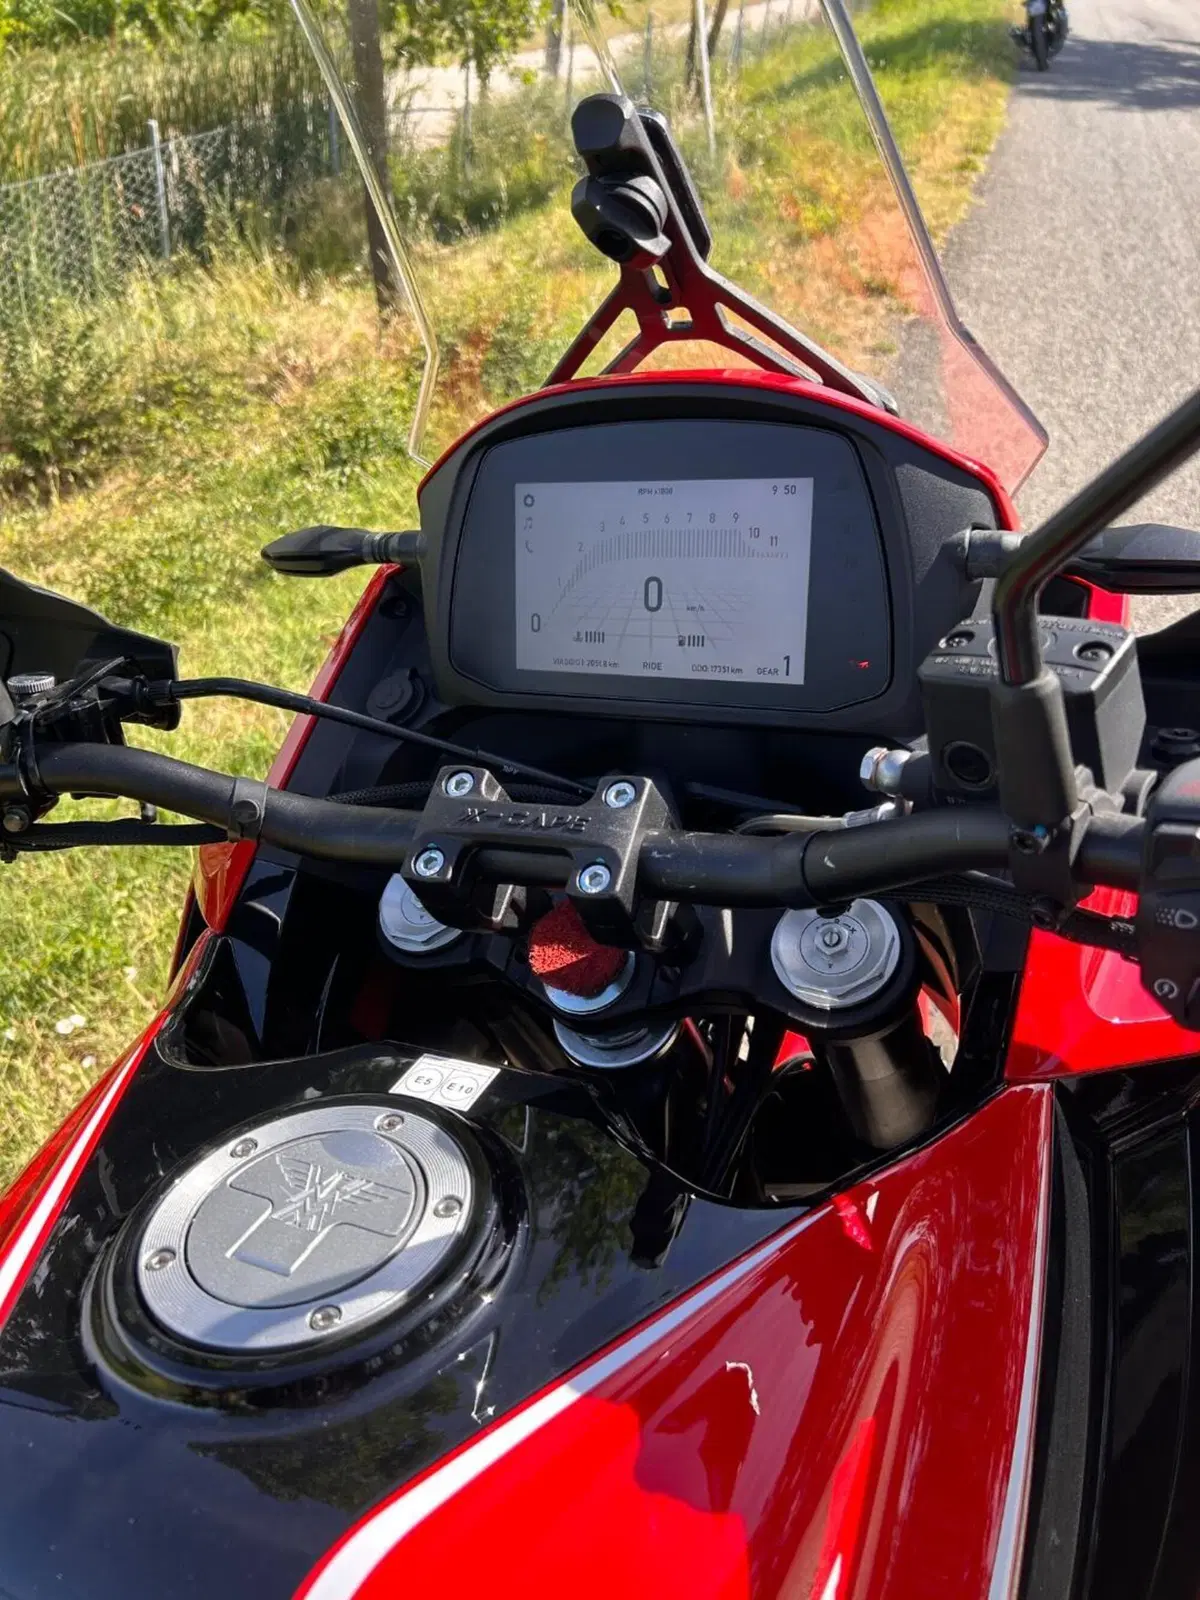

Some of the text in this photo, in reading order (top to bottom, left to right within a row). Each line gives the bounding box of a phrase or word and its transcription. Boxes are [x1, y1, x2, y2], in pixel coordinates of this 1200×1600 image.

[784, 484, 797, 495] 50
[577, 541, 584, 552] 2
[600, 521, 606, 532] 3
[619, 515, 626, 525] 4
[642, 513, 649, 523] 5
[664, 513, 670, 524] 6
[686, 512, 693, 523] 7
[709, 512, 716, 523] 8
[733, 512, 740, 523] 9
[748, 527, 760, 539] 10
[769, 535, 778, 547] 11
[643, 576, 664, 613] 0
[531, 612, 541, 633] 0
[642, 661, 664, 671] RIDE
[757, 654, 791, 677] GEAR 1
[457, 807, 593, 833] X-CAPE
[414, 1075, 433, 1086] E5
[446, 1082, 473, 1094] E10
